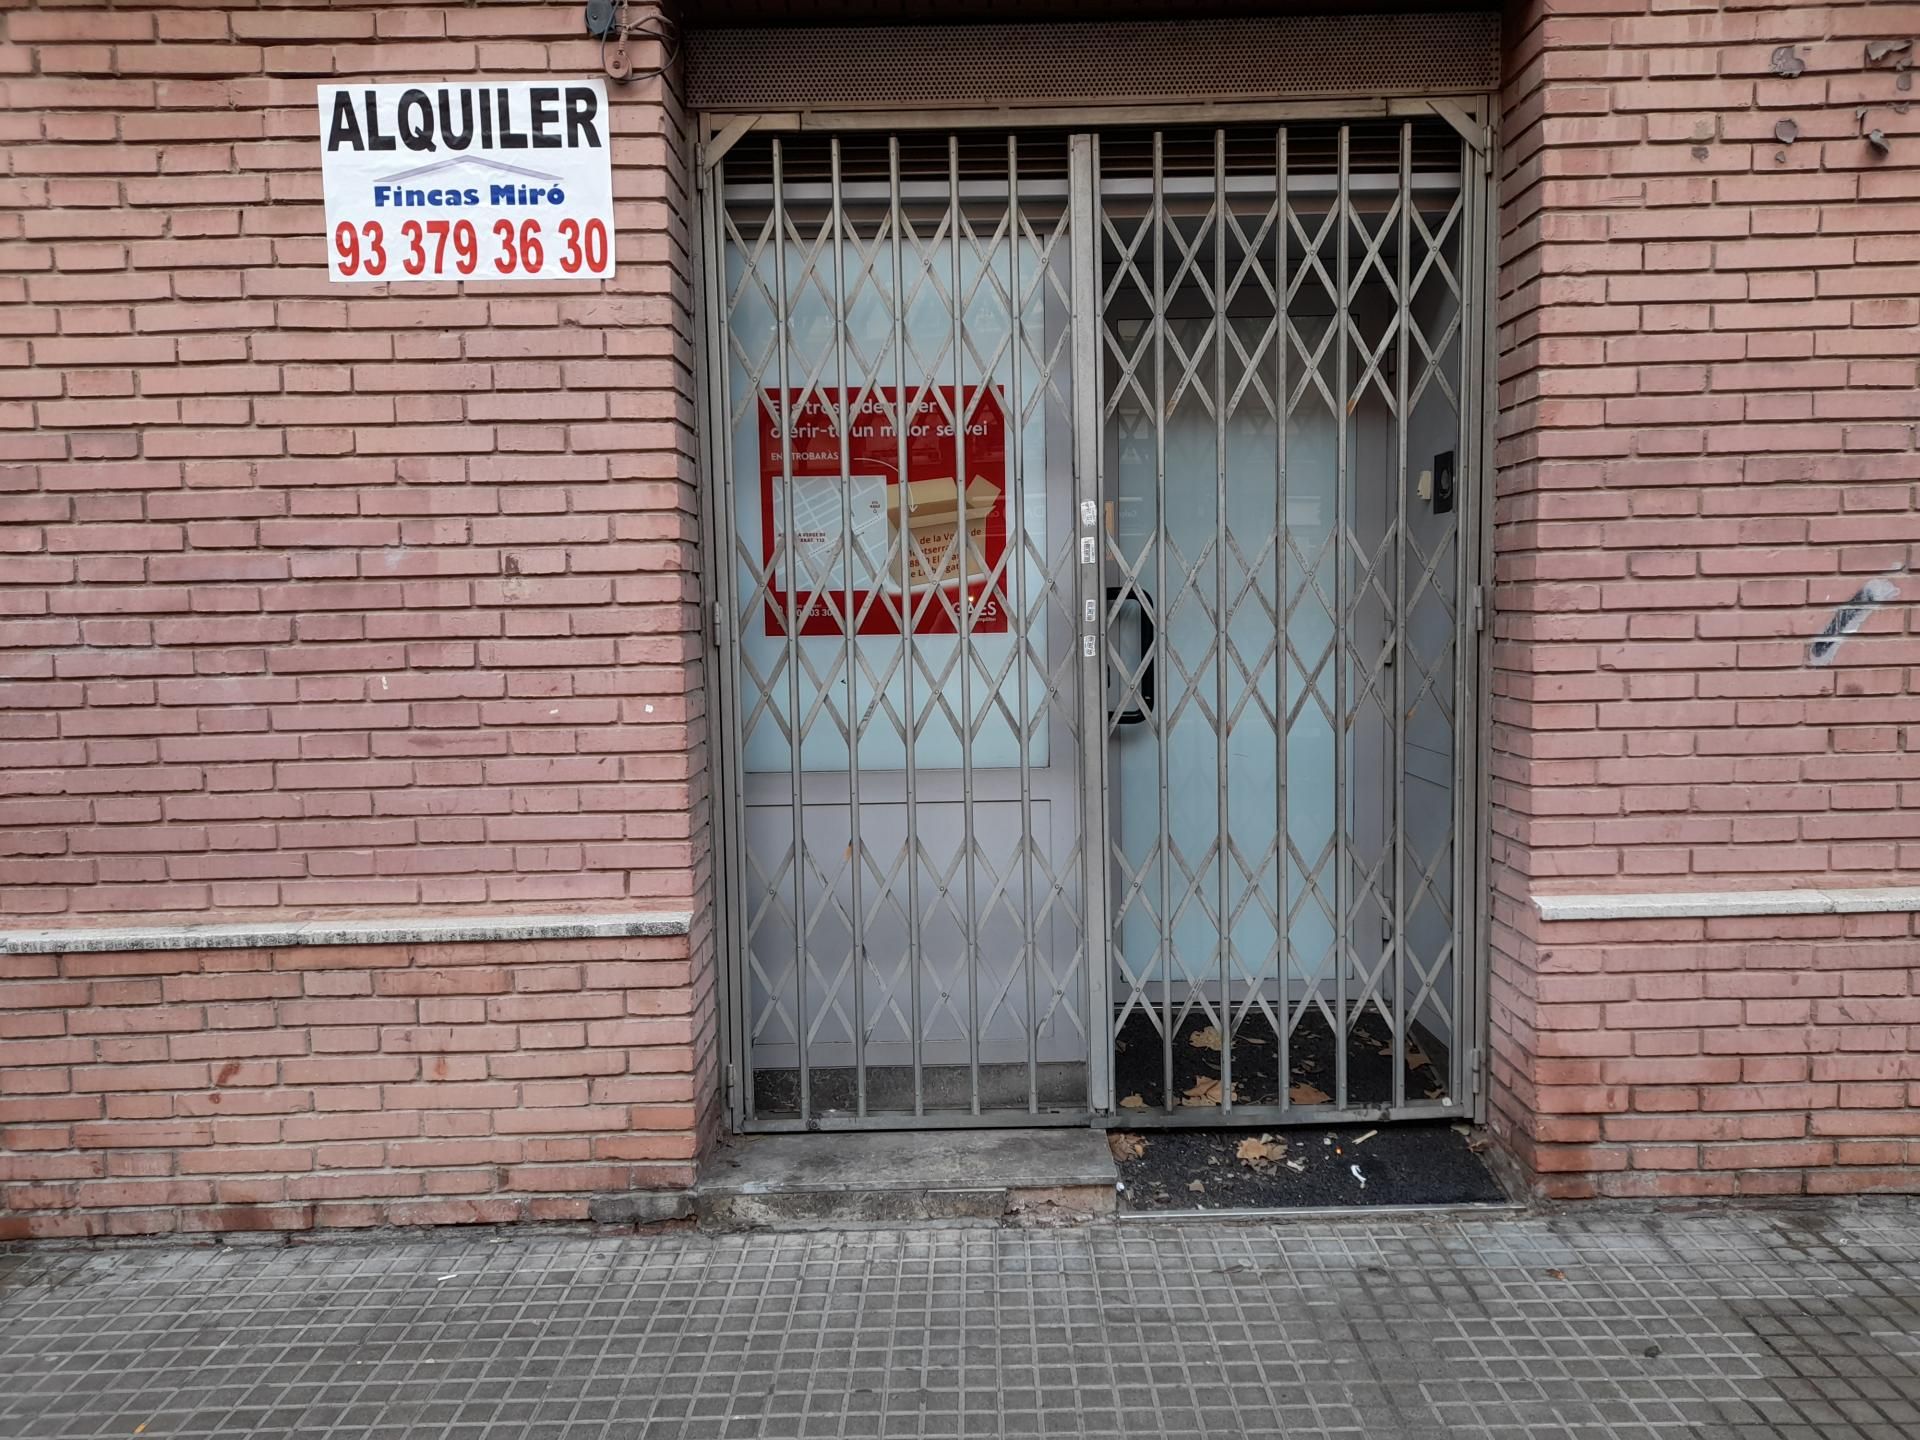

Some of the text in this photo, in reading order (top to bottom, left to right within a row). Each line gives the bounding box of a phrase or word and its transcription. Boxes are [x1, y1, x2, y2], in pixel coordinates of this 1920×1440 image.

[327, 87, 602, 152] ALQUILER
[373, 184, 565, 207] Fincas Miró
[335, 217, 608, 276] 93 379 36 30
[771, 422, 840, 438] oerir-t
[852, 425, 874, 438] un
[936, 420, 988, 437] sevei
[791, 450, 839, 461] TROBARÀS
[920, 536, 931, 544] de
[933, 534, 941, 542] la
[971, 528, 982, 536] de
